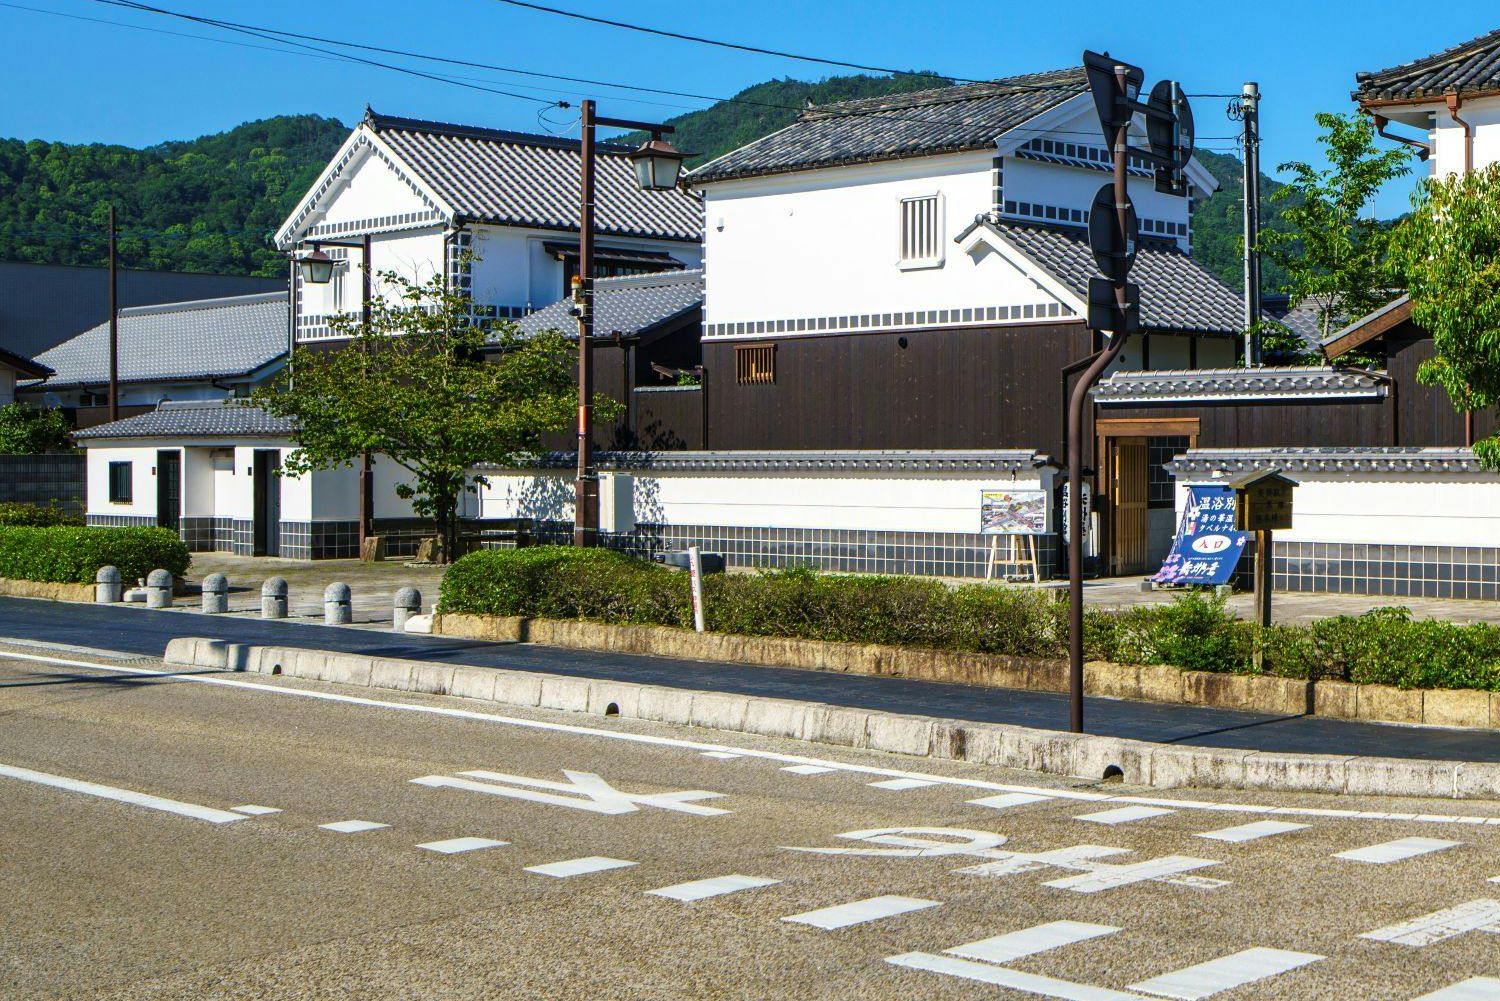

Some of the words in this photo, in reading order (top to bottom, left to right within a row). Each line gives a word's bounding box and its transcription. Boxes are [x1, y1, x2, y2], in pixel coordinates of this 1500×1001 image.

[1201, 513, 1236, 523] 湯の華温
[1199, 539, 1223, 549] 入口
